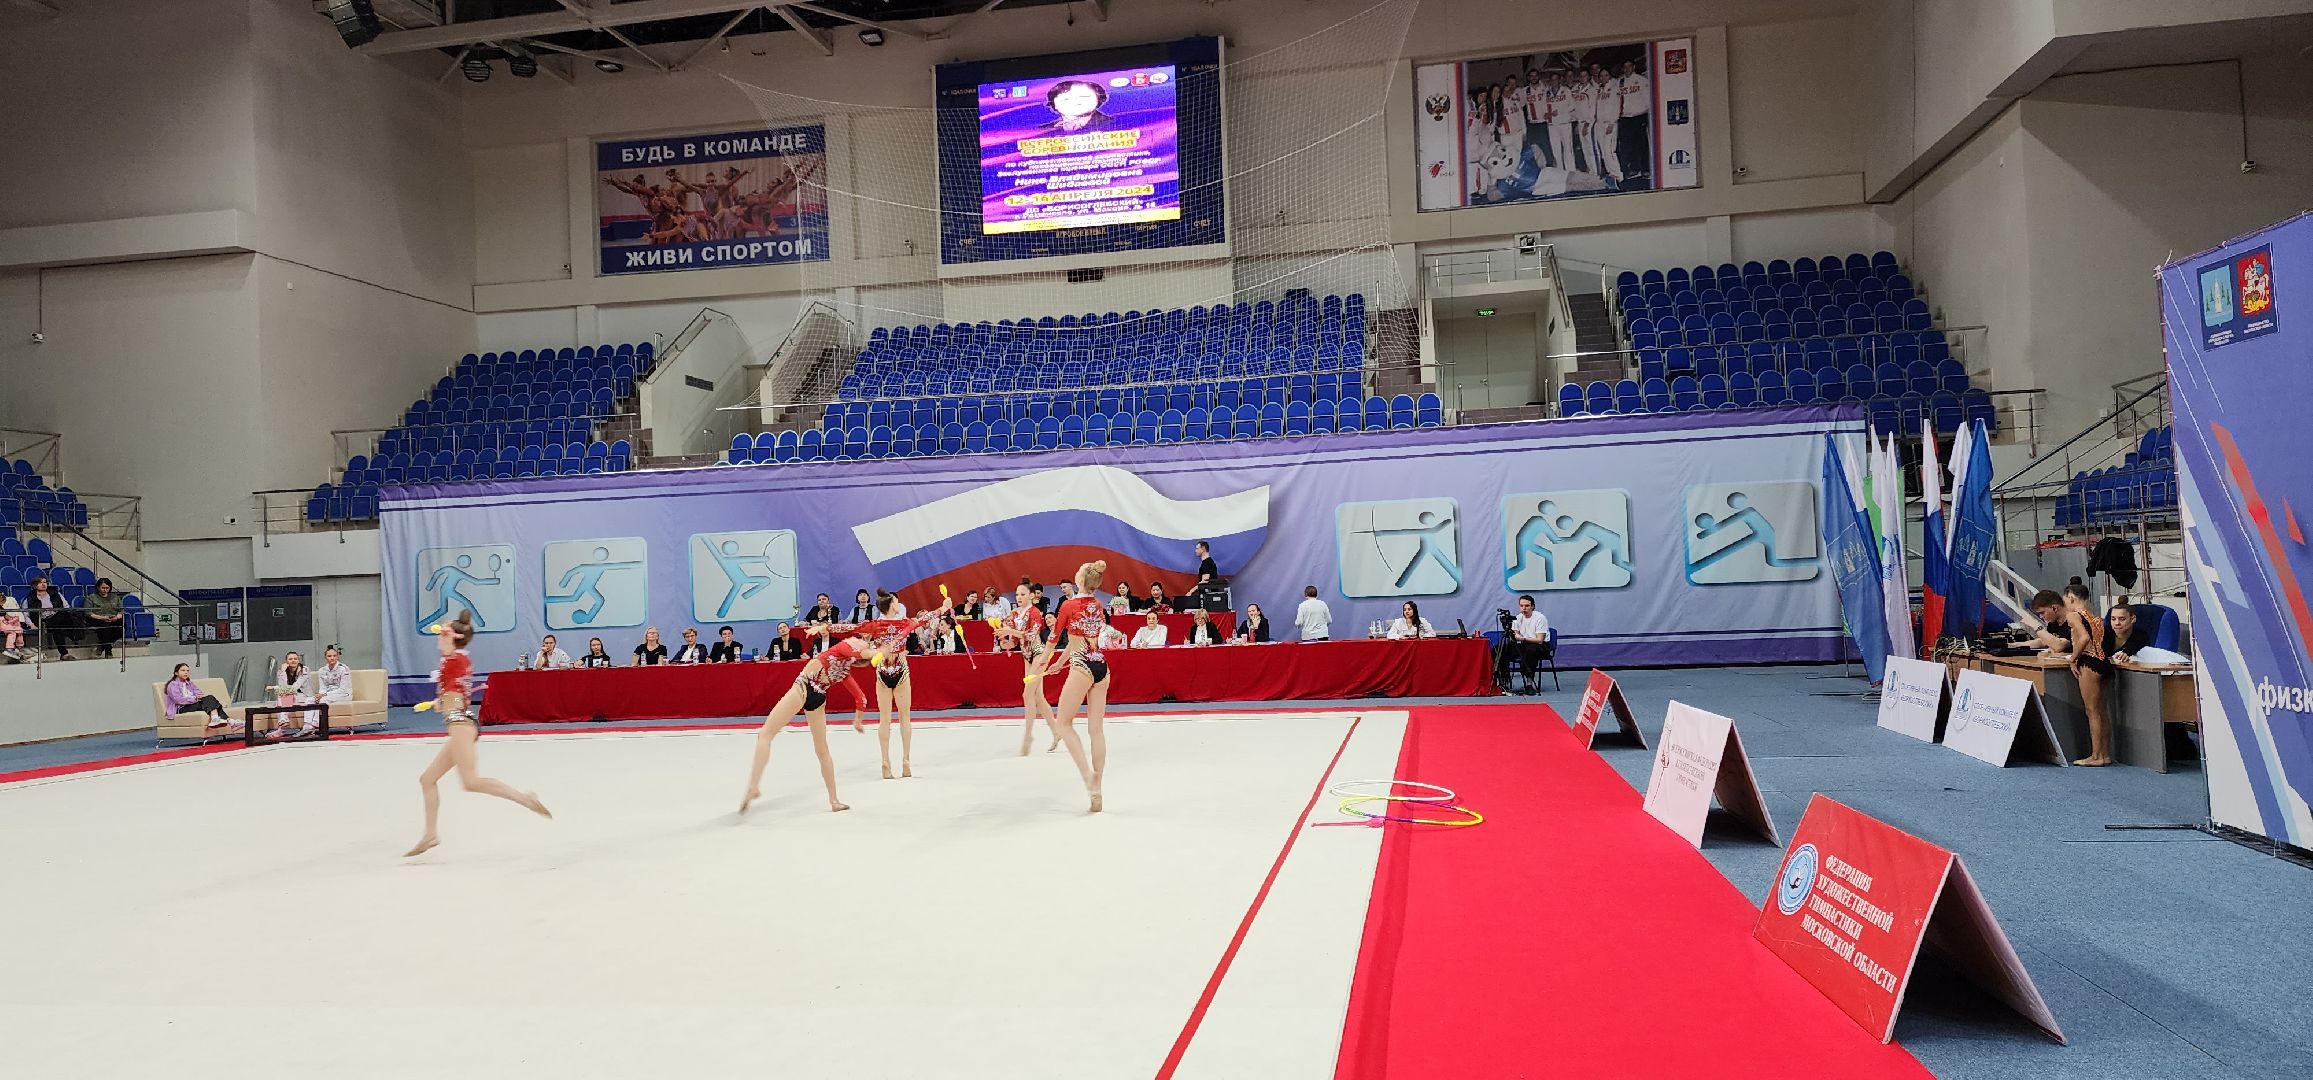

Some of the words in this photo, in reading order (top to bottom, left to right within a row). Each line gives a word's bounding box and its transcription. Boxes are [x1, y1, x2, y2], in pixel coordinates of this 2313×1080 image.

[621, 145, 676, 164] БУДЬ
[683, 143, 696, 158] В
[703, 133, 807, 157] КОМАНДЕ
[1051, 189, 1113, 201] АПРЕЛЯ
[1116, 185, 1152, 196] 2024
[626, 248, 693, 267] ЖИВИ
[701, 238, 812, 262] СПОРТОМ
[1825, 855, 1873, 893] ФЕДЕРАЦИЯ
[1808, 893, 1864, 941] ГИМНАСТИКИ
[1816, 873, 1894, 934] ХУДОЖЕСТВЕННОЙ
[1800, 913, 1856, 963] МОСКОВСКОЙ
[1853, 951, 1898, 994] ОБЛАСТИ
